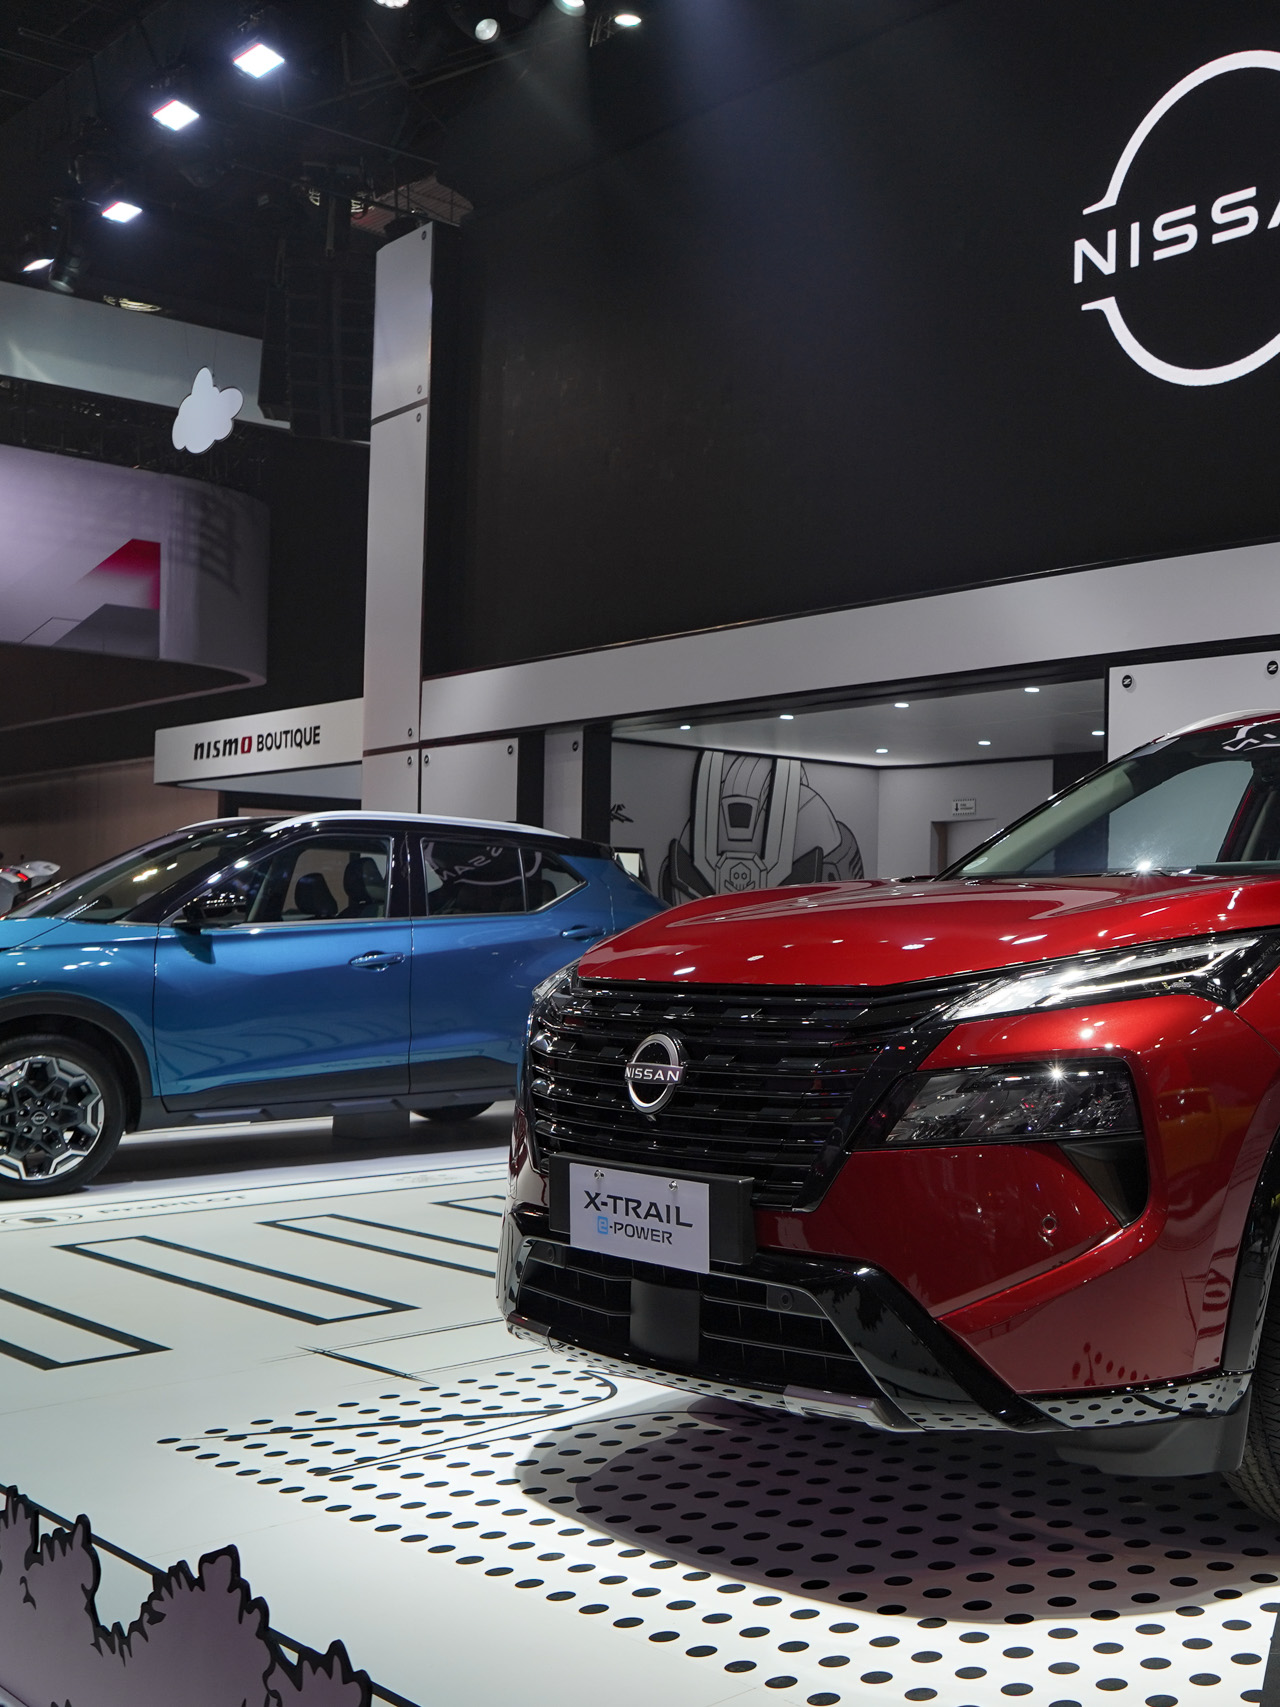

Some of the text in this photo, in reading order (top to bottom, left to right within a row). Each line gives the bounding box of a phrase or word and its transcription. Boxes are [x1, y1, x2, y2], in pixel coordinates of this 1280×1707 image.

[256, 725, 321, 752] BOUTIQUE
[624, 1066, 680, 1082] NISSAN
[584, 1190, 693, 1228] X-TRAIL
[597, 1216, 673, 1245] e-POWER
